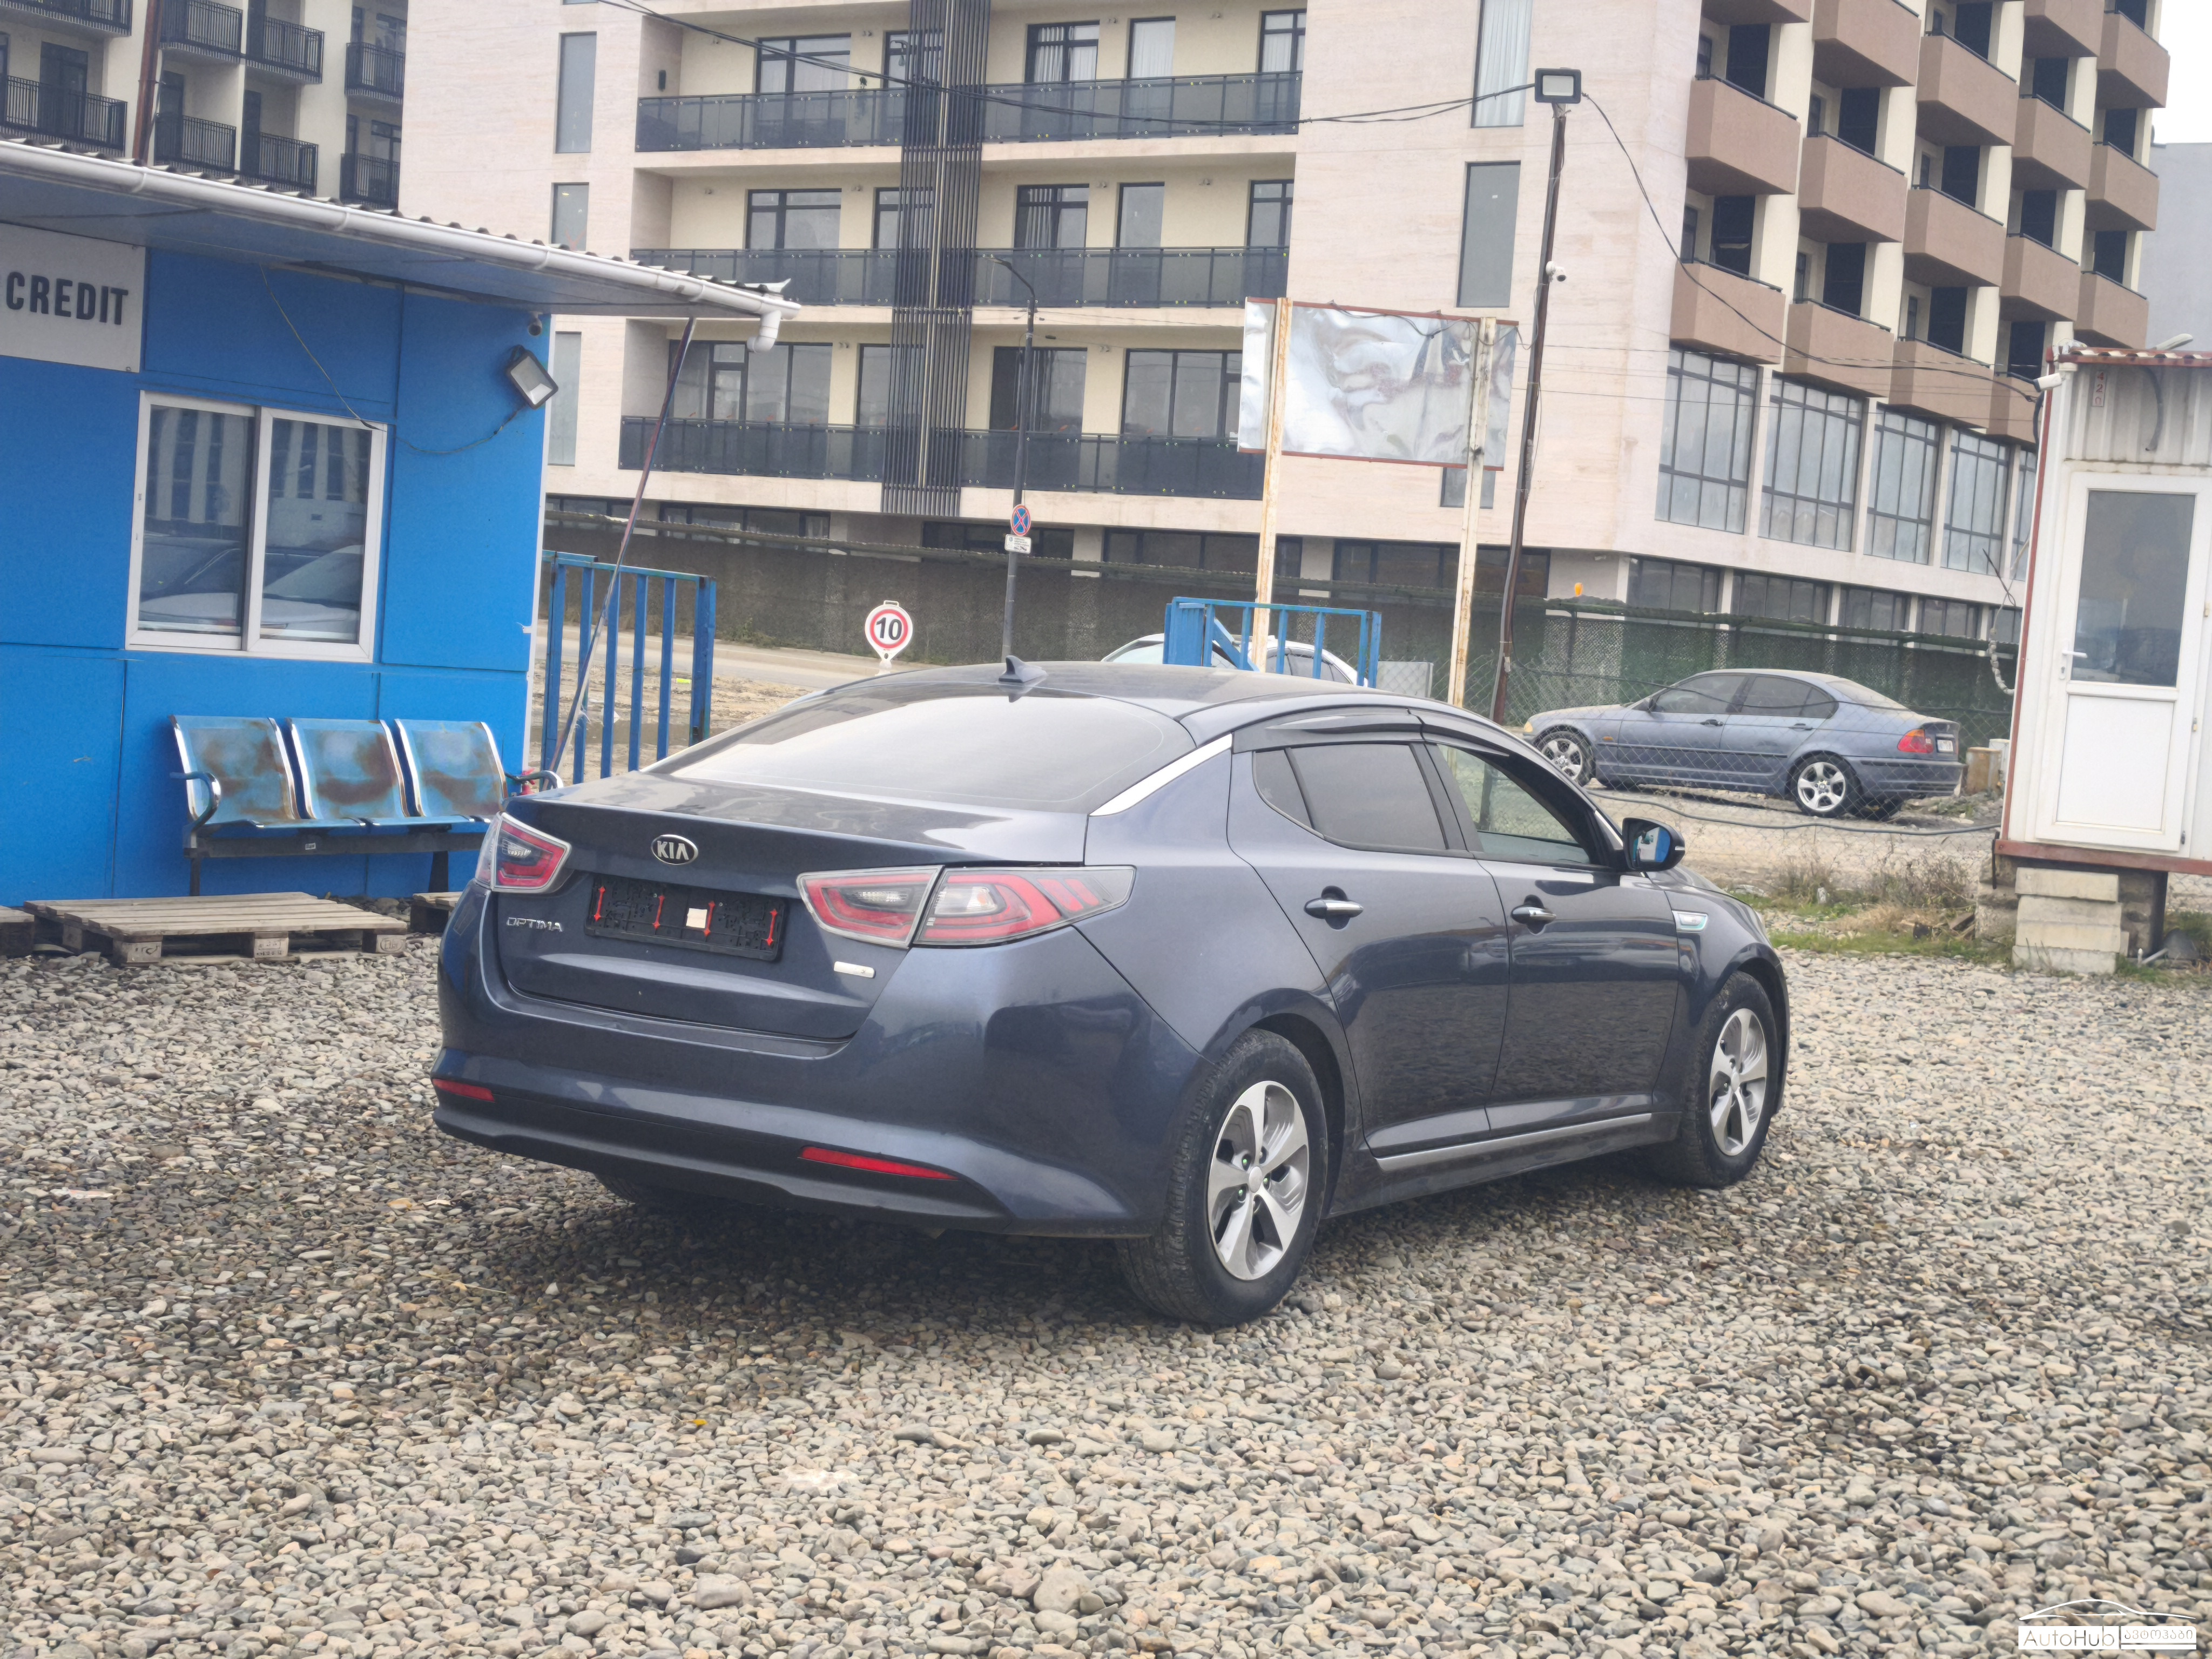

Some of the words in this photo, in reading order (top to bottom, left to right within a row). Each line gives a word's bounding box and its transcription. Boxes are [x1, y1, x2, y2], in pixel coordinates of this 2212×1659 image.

[6, 271, 129, 325] CREDIT
[875, 617, 902, 640] 10
[657, 840, 689, 860] KIA
[507, 917, 563, 932] OPTIMA
